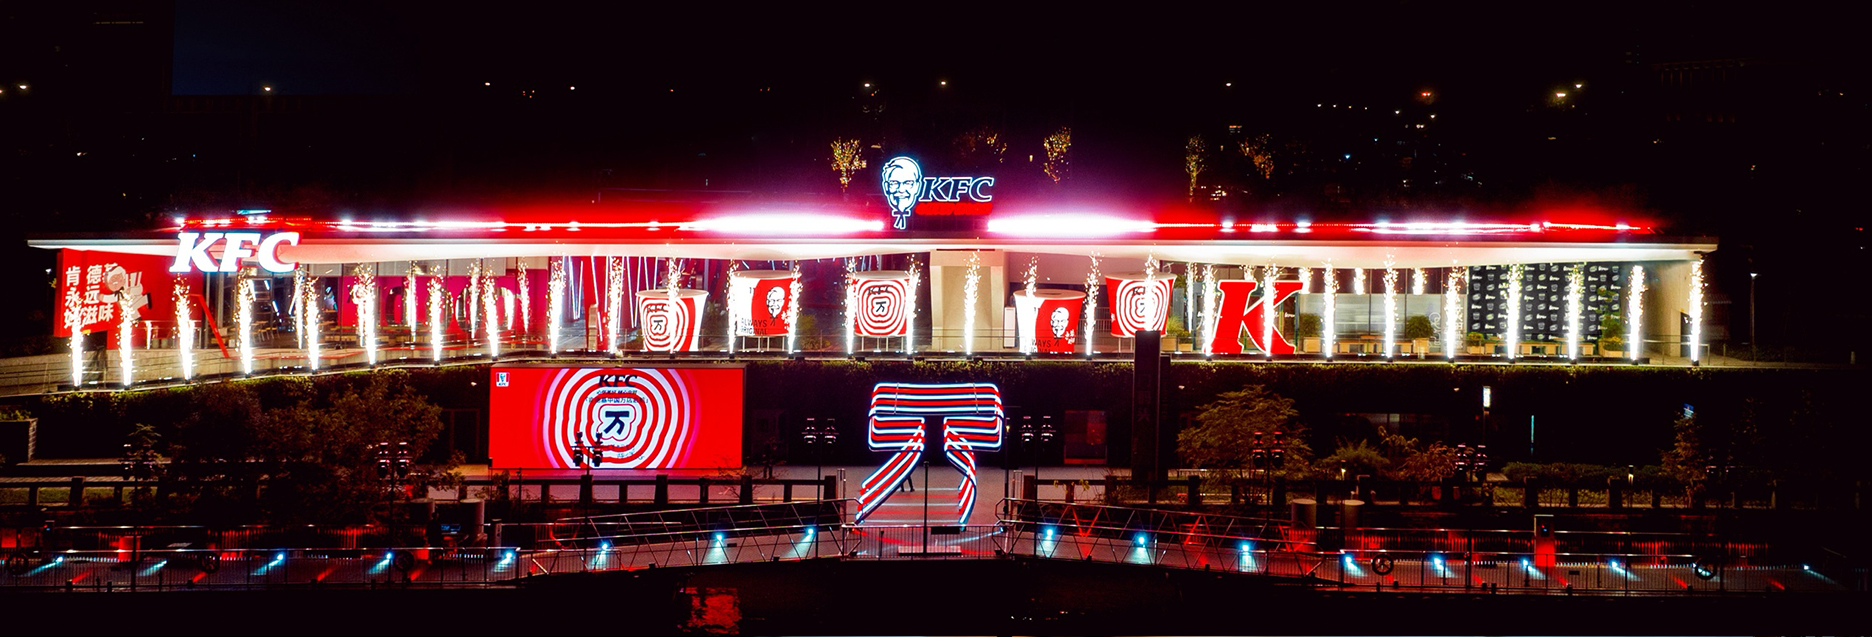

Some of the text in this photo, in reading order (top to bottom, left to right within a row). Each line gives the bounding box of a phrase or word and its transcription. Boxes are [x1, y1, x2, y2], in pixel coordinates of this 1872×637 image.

[917, 176, 995, 202] KFC
[168, 231, 301, 273] KFC
[65, 262, 118, 286] 肯德
[1204, 279, 1304, 355] K
[598, 374, 638, 387] KFC
[603, 410, 631, 436] 万
